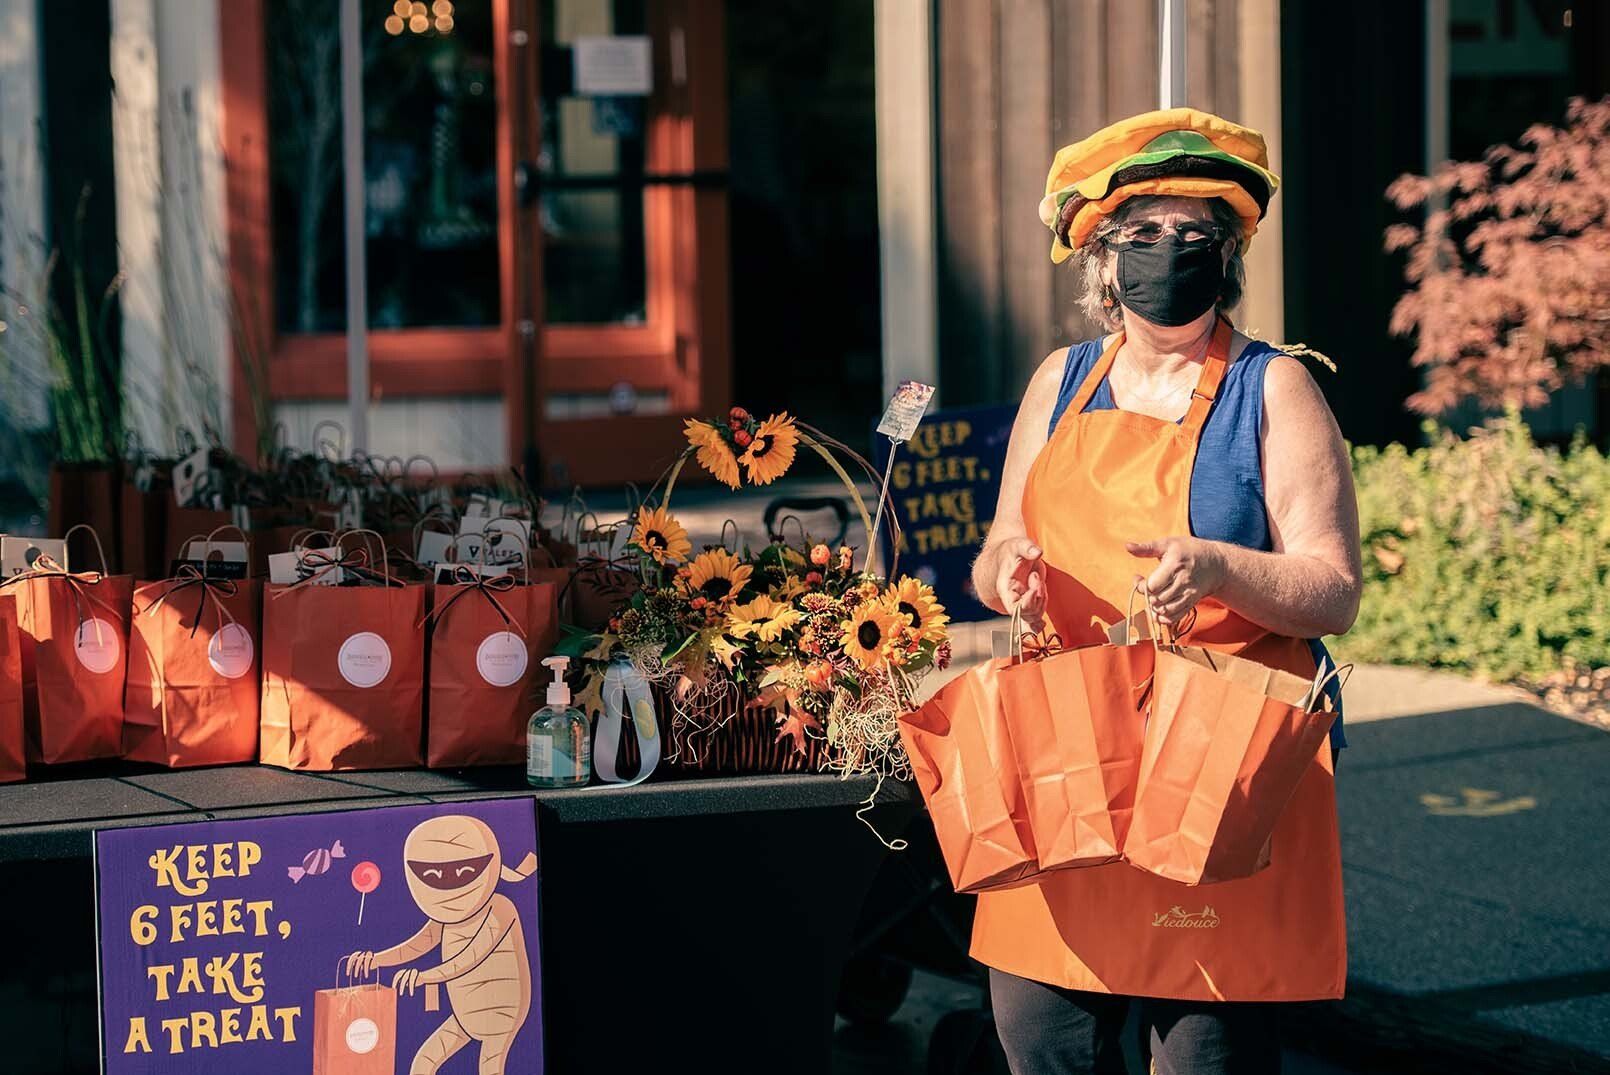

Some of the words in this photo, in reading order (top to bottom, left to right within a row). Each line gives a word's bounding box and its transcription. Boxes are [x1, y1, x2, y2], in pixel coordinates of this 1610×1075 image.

[892, 460, 912, 490] 6
[904, 488, 976, 522] TAKE
[148, 840, 263, 896] KEEP
[130, 904, 160, 946] 6
[169, 898, 293, 944] FEET,
[147, 951, 266, 1004] TAKE
[123, 1016, 153, 1054] A
[161, 1005, 302, 1055] TREAT
